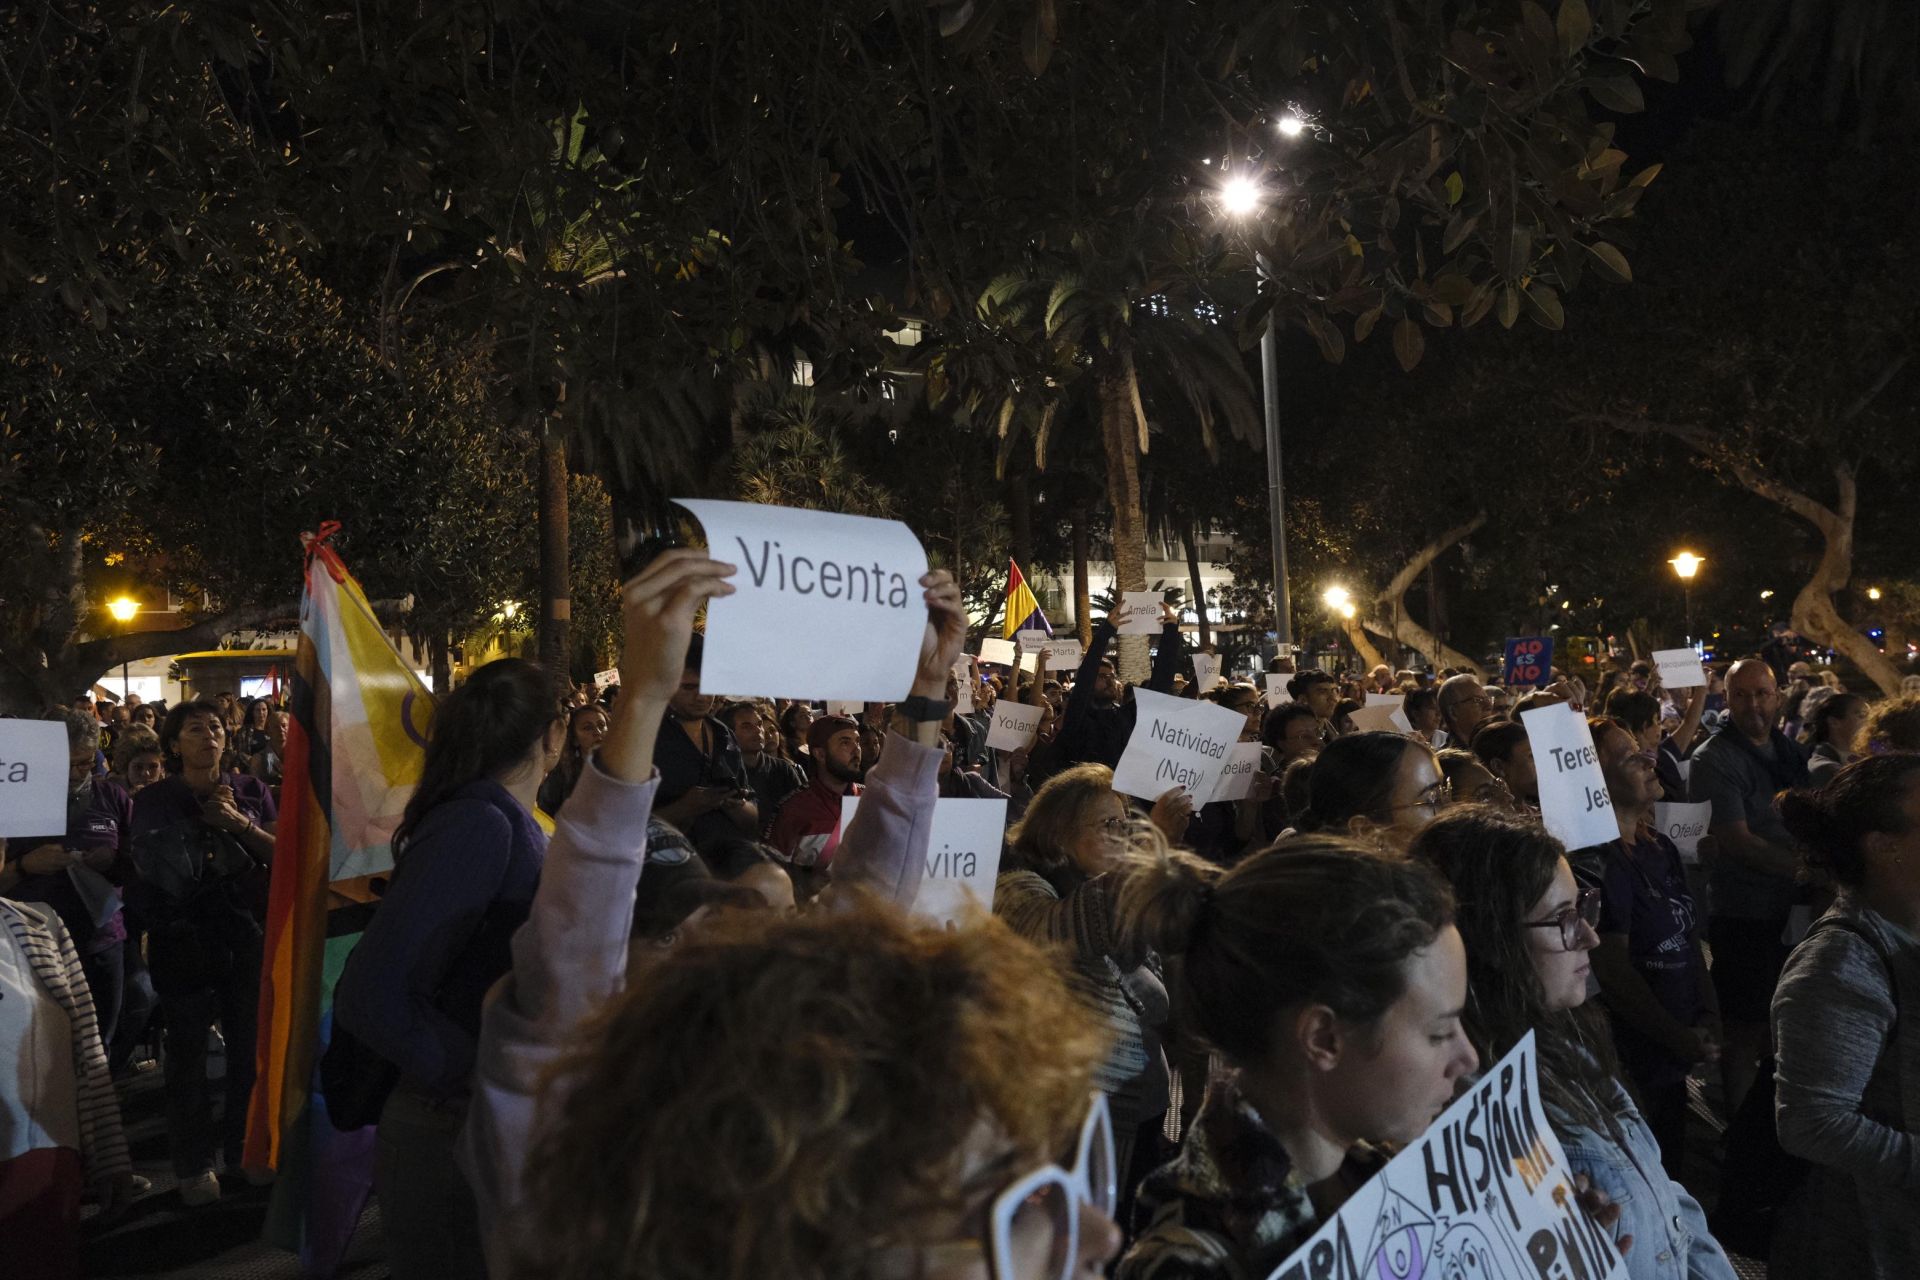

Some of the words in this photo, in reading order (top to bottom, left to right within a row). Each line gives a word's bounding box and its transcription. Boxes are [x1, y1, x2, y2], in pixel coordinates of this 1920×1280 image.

[735, 535, 908, 609] Vicenta
[1128, 604, 1156, 615] Amelia
[1053, 648, 1075, 656] Marta
[1513, 639, 1544, 656] NO
[1516, 653, 1536, 665] ES
[1509, 665, 1541, 684] NO
[1151, 718, 1227, 759] Natividad
[1155, 758, 1205, 791] (Naty)
[1220, 760, 1252, 775] oelia
[1669, 822, 1704, 839] Ofelia
[1422, 1051, 1554, 1231] HISTORIA
